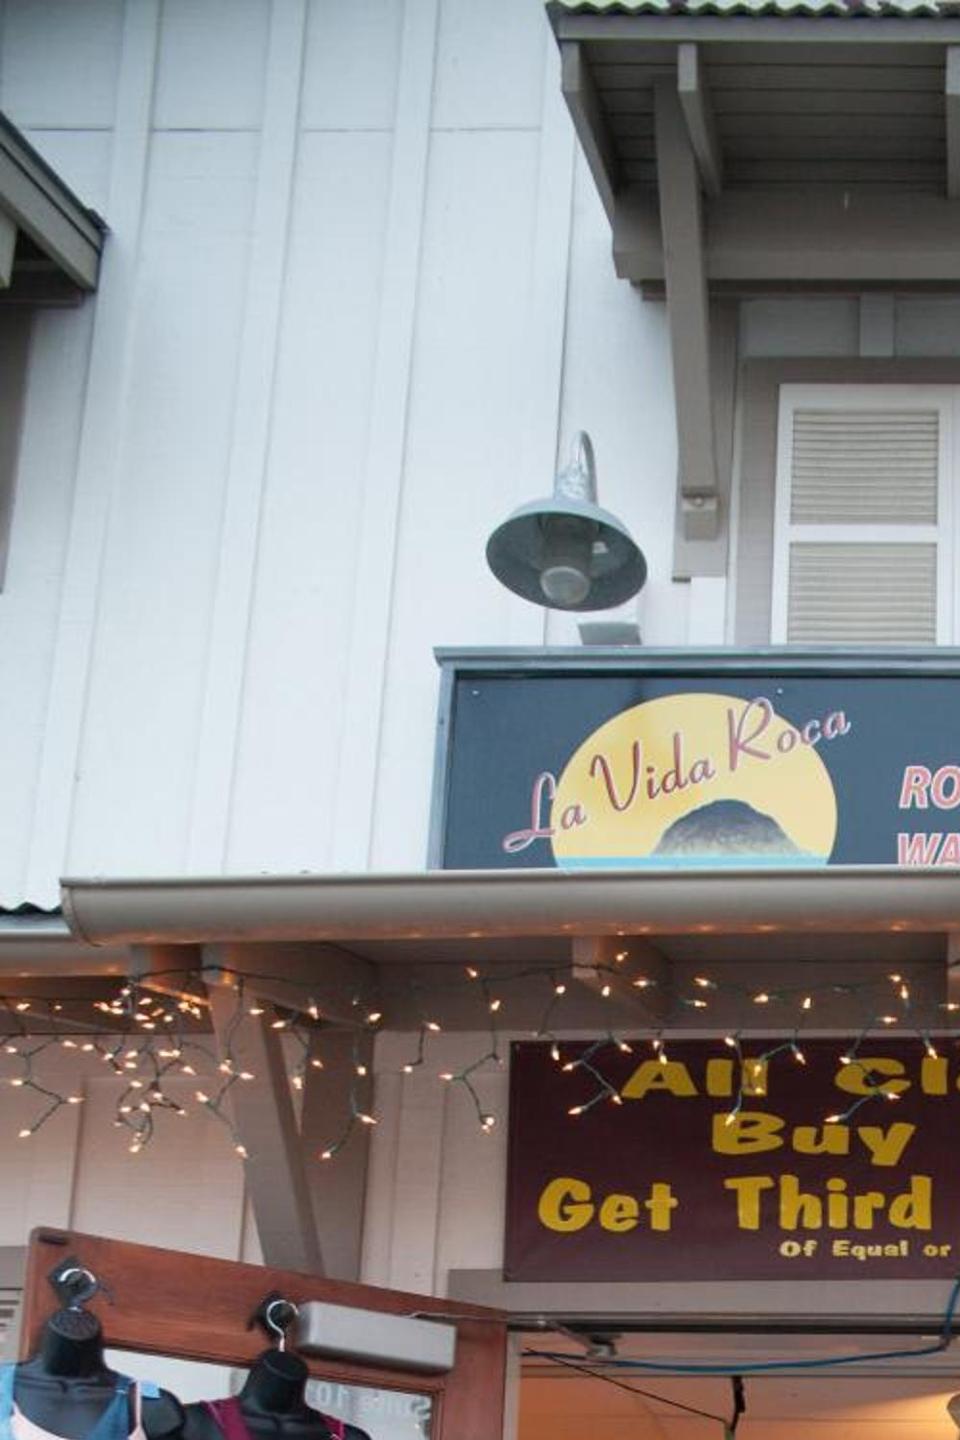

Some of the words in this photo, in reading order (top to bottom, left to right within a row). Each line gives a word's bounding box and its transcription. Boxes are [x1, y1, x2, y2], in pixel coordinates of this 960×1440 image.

[502, 771, 588, 853] La
[588, 731, 716, 812] Vida
[726, 696, 852, 773] Roca
[620, 1057, 768, 1099] All
[712, 1110, 917, 1167] Buy
[537, 1176, 679, 1233] Get
[723, 1173, 933, 1231] Third
[778, 1239, 818, 1258] Of
[832, 1239, 909, 1261] Equal
[922, 1244, 952, 1258] or
